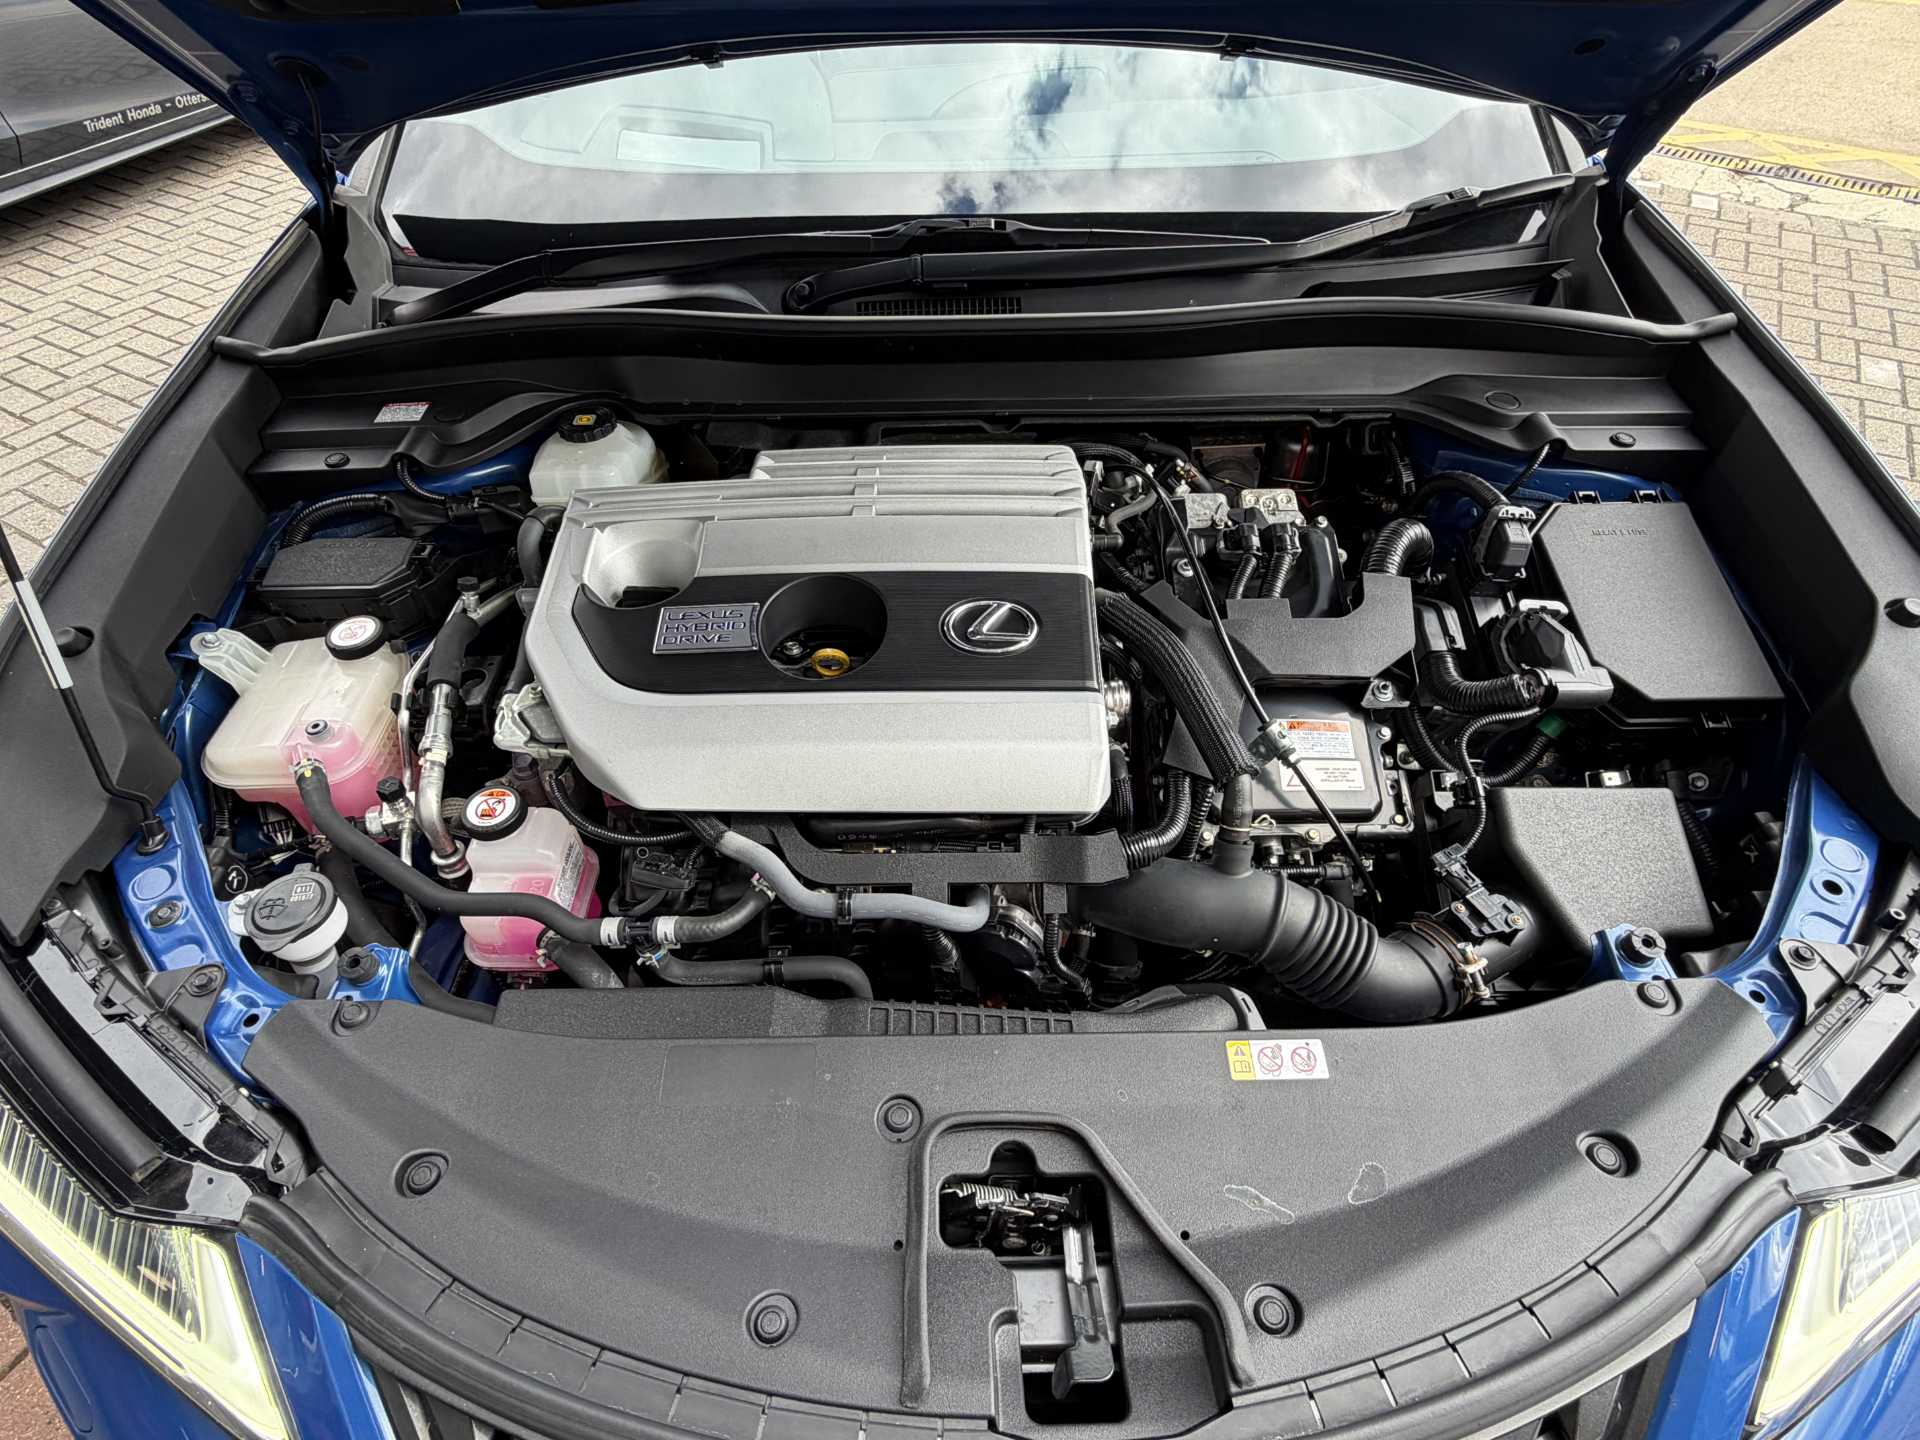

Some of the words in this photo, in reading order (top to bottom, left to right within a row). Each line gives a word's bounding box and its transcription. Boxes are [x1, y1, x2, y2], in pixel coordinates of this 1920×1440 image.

[83, 114, 124, 133] Trident
[126, 103, 162, 121] Honda
[175, 92, 210, 108] Otters
[665, 609, 744, 621] LEXUS
[663, 621, 746, 633] HYBRID
[660, 633, 734, 645] DRIVE
